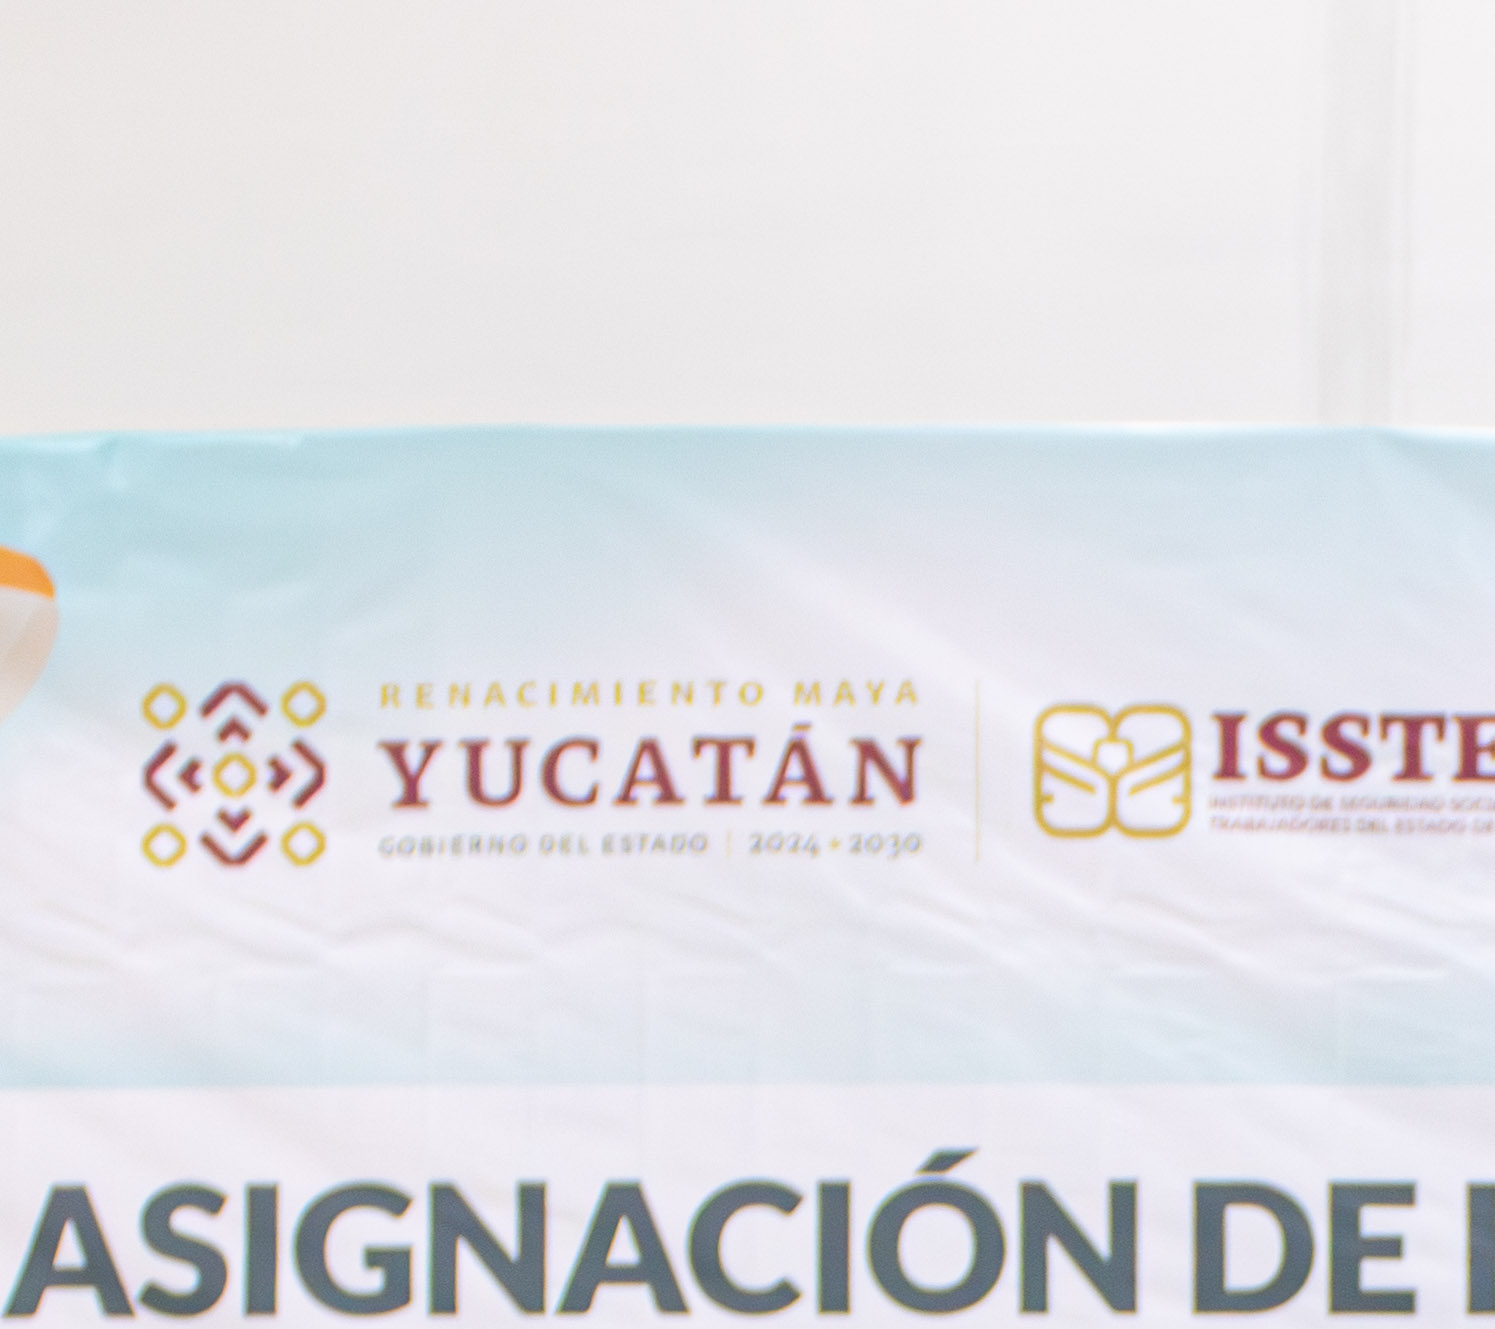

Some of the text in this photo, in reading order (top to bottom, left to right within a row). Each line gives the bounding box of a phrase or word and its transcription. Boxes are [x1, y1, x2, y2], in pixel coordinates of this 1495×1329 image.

[379, 678, 920, 710] RENACIMIENTO MAYA
[377, 722, 923, 809] YUCATÁN
[378, 834, 527, 857] GOBIERNO
[538, 834, 590, 856] DEL
[601, 833, 709, 856] ESTADO
[4, 1151, 1137, 1319] ASIGNACIÓN
[1193, 1182, 1416, 1316] DE
